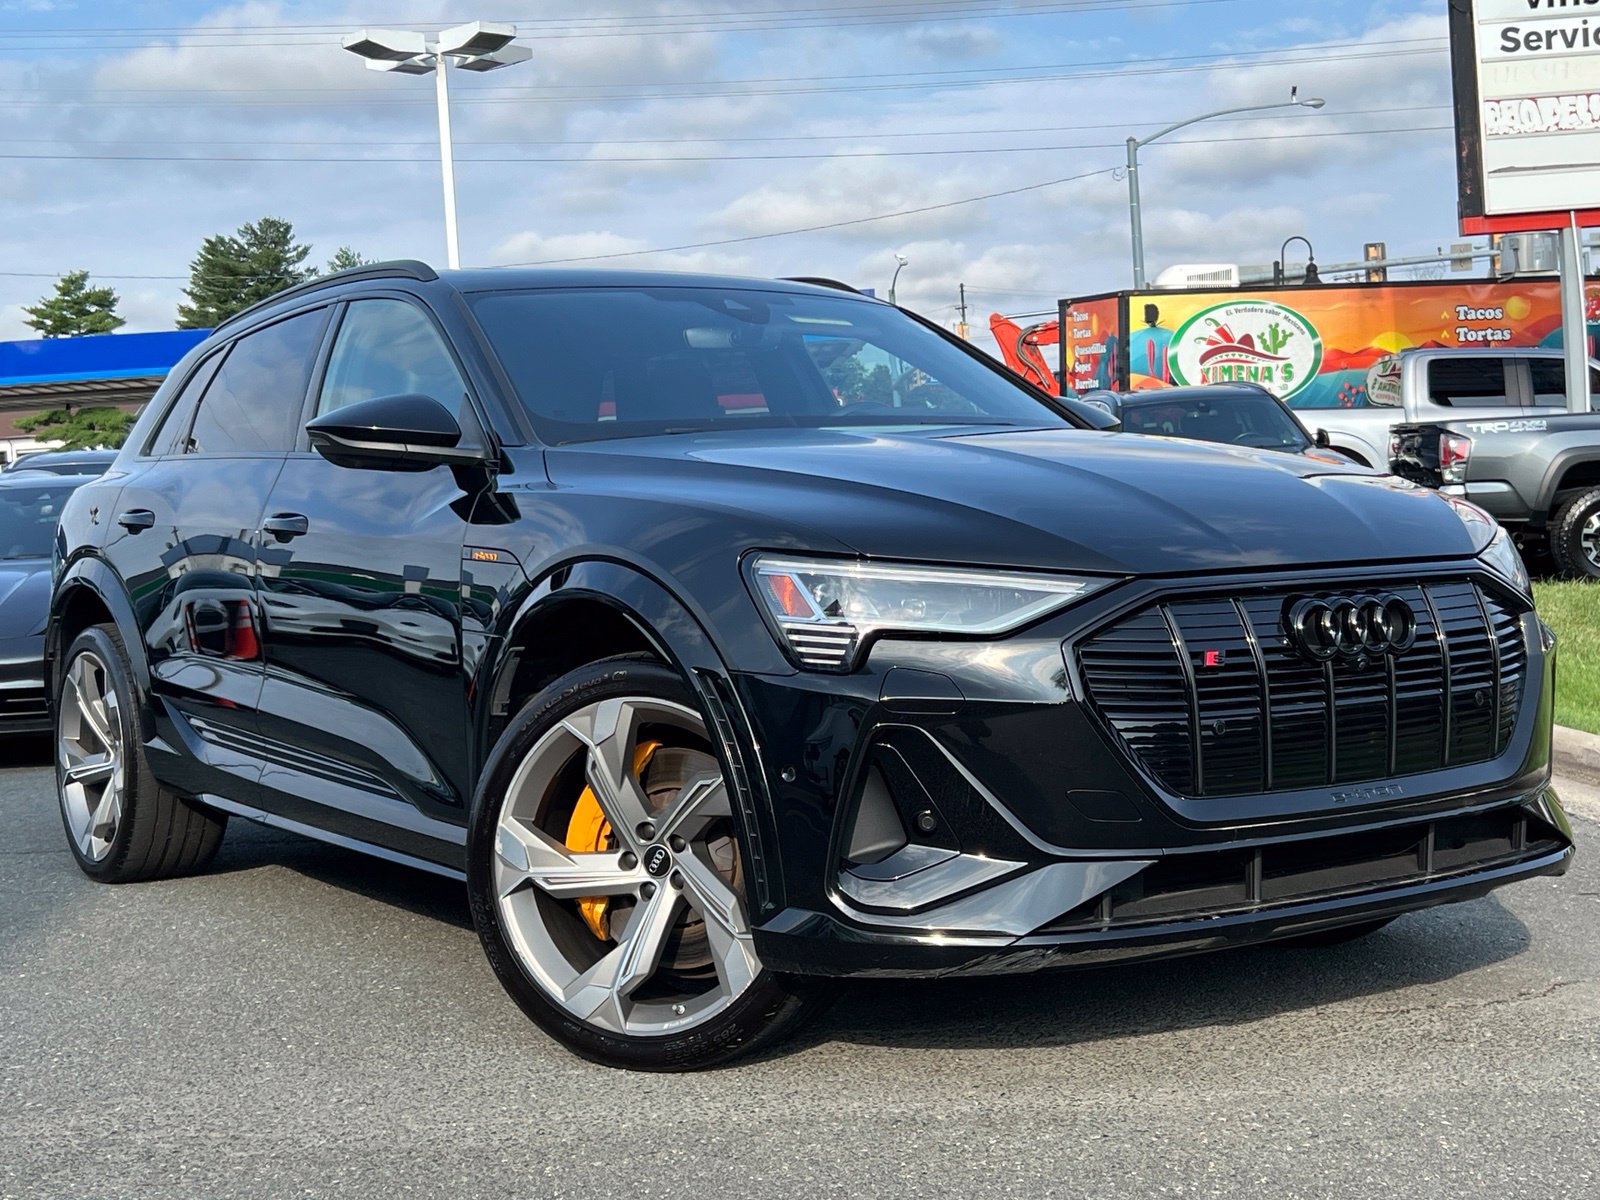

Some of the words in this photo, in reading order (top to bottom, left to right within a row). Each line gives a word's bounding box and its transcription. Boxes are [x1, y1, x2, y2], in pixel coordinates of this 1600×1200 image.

[1073, 311, 1088, 322] Tacos
[1234, 306, 1264, 314] Verdadero
[1265, 308, 1281, 317] sabor
[1455, 305, 1503, 321] Tacos
[1073, 328, 1091, 339] Tortas
[1455, 326, 1511, 342] Tortas
[1200, 362, 1294, 385] XIMENA'S
[1074, 378, 1099, 390] Burritos
